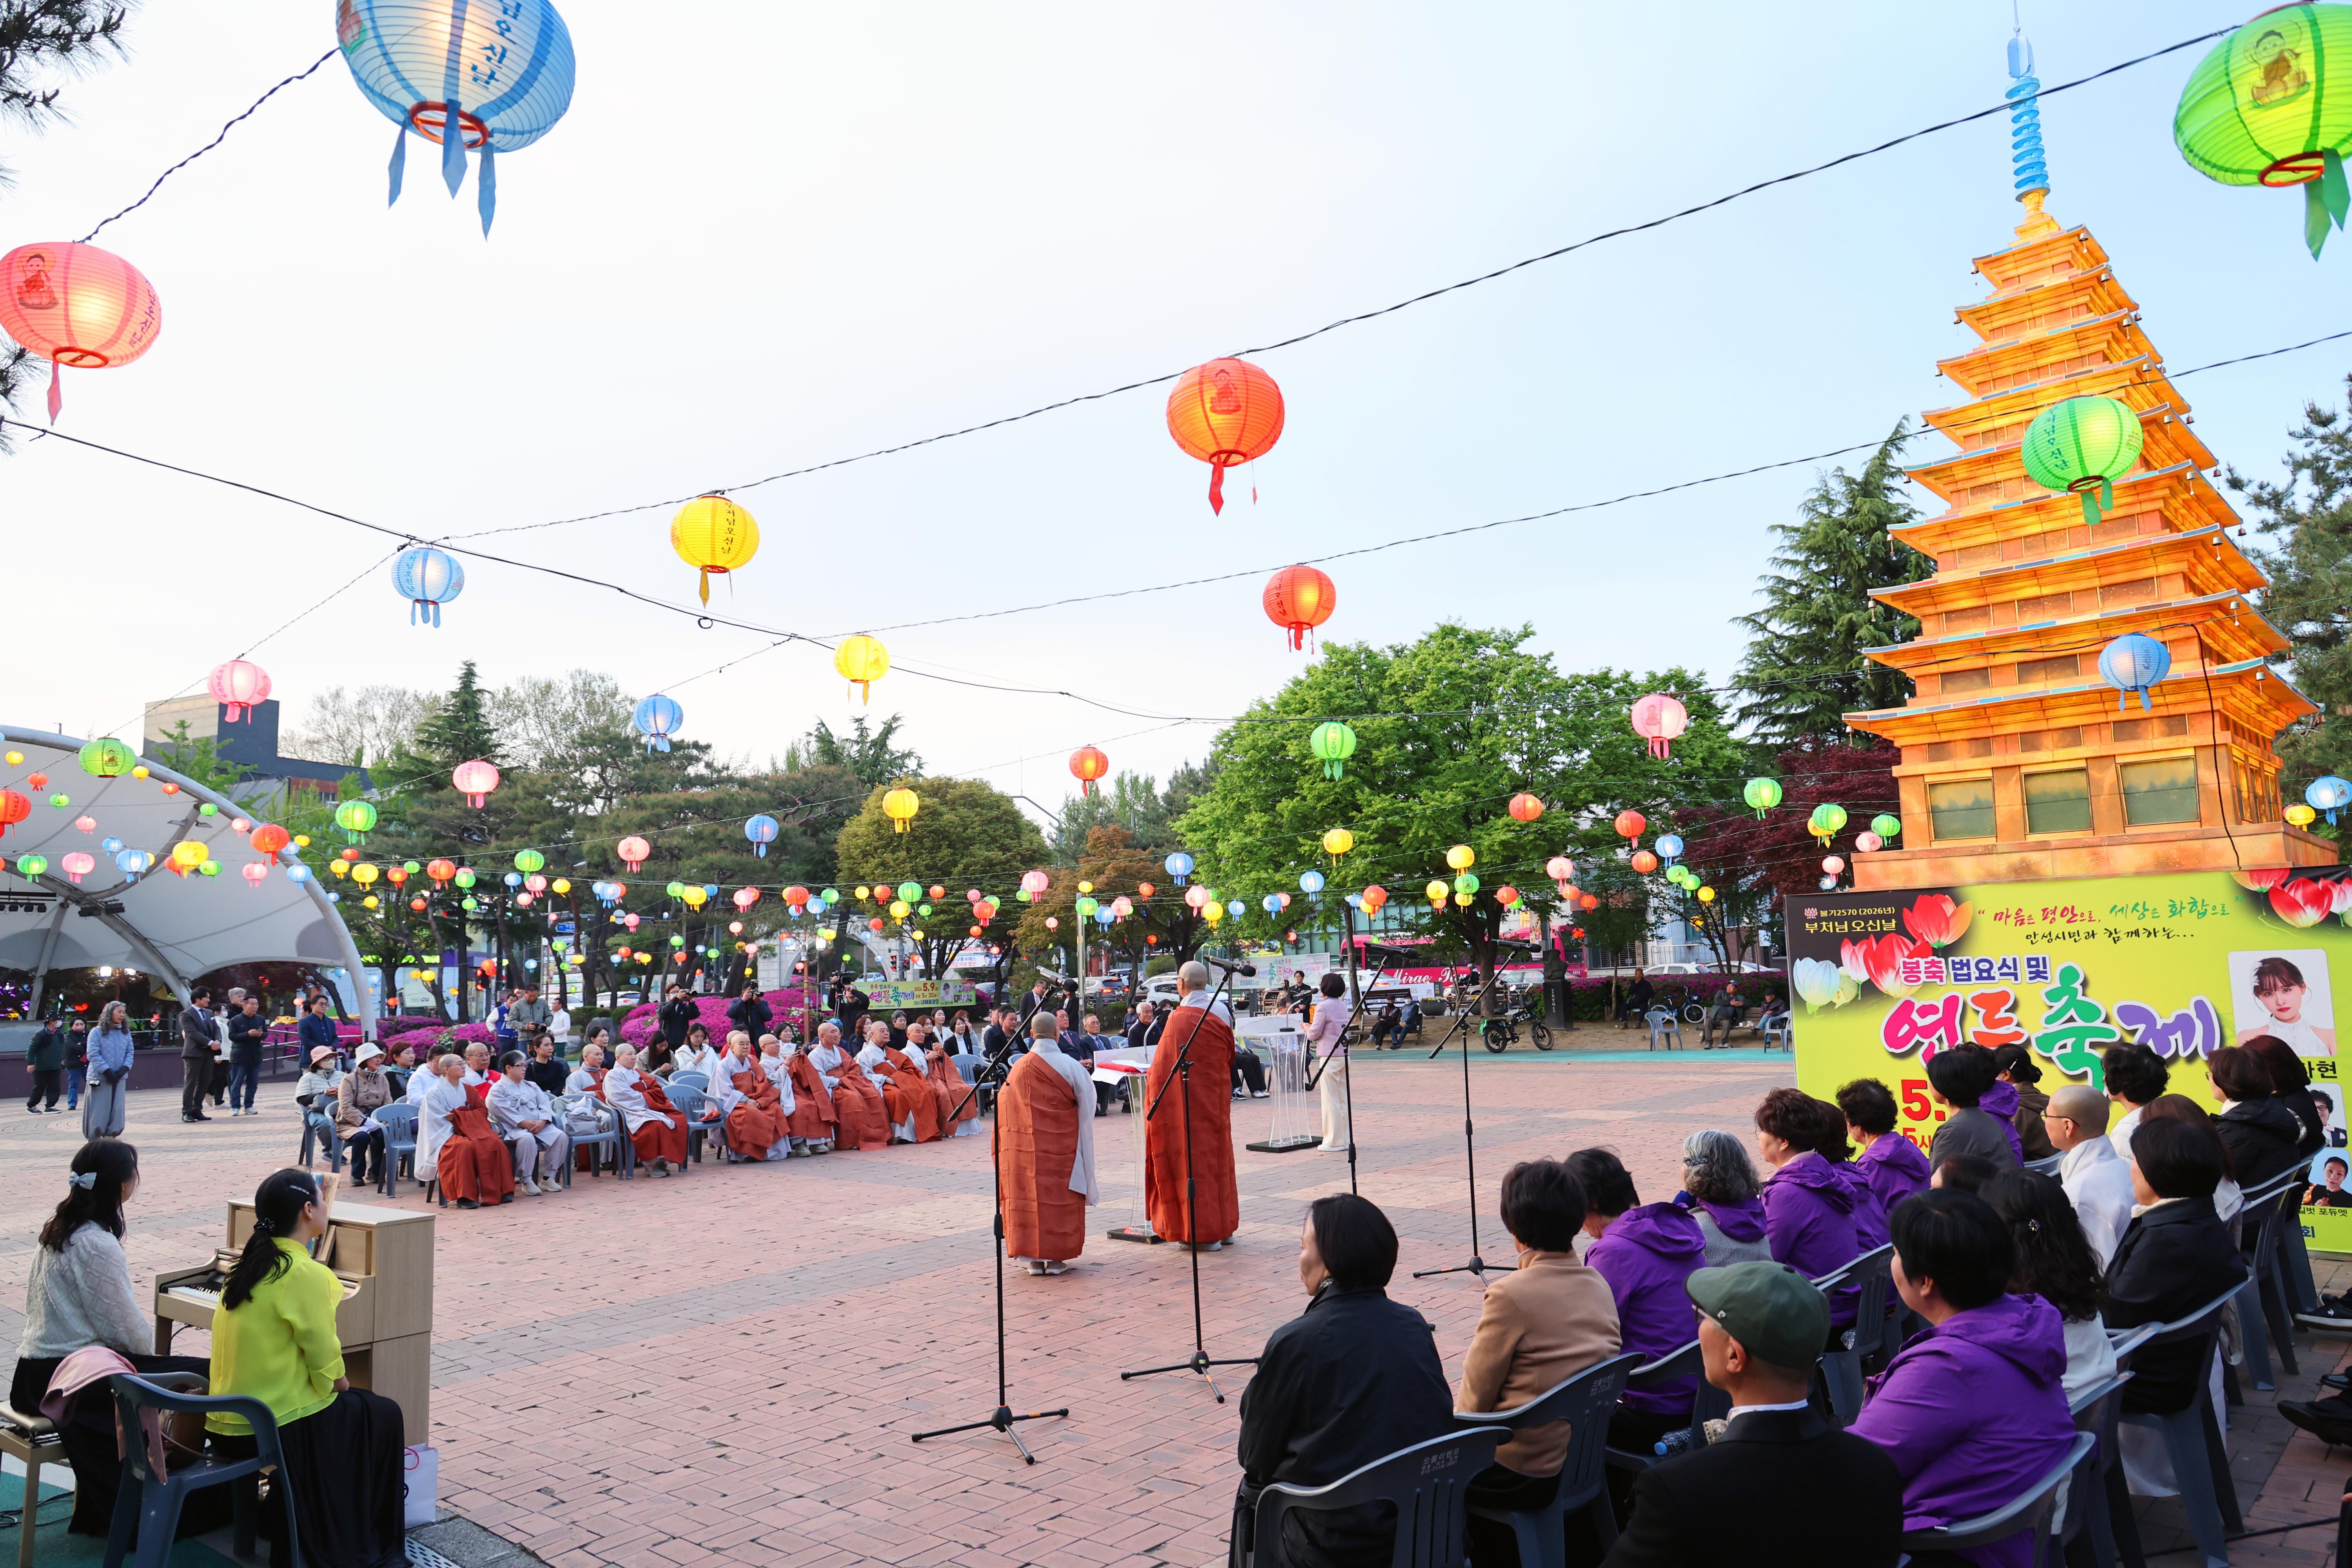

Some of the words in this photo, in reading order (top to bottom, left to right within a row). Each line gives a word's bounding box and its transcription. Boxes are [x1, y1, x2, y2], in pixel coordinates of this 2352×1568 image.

[1820, 908, 1857, 917] 불기2570
[1859, 907, 1895, 916] (2026년)
[1994, 907, 2035, 926] 마음은
[2041, 905, 2101, 924] 평안으로,
[2109, 900, 2160, 920] 세상은
[2167, 896, 2230, 919] 화합으로
[1805, 920, 1848, 934] 부처님
[1851, 918, 1896, 932] 오신날
[2025, 929, 2098, 945] 안성시민과
[1393, 969, 1433, 984] Mirae
[1902, 959, 1944, 983] 봉축
[1951, 957, 2018, 982] 법요식
[2027, 956, 2049, 981] 및
[869, 985, 914, 1007] 연등축제
[2319, 1208, 2348, 1217] 포듀엣
